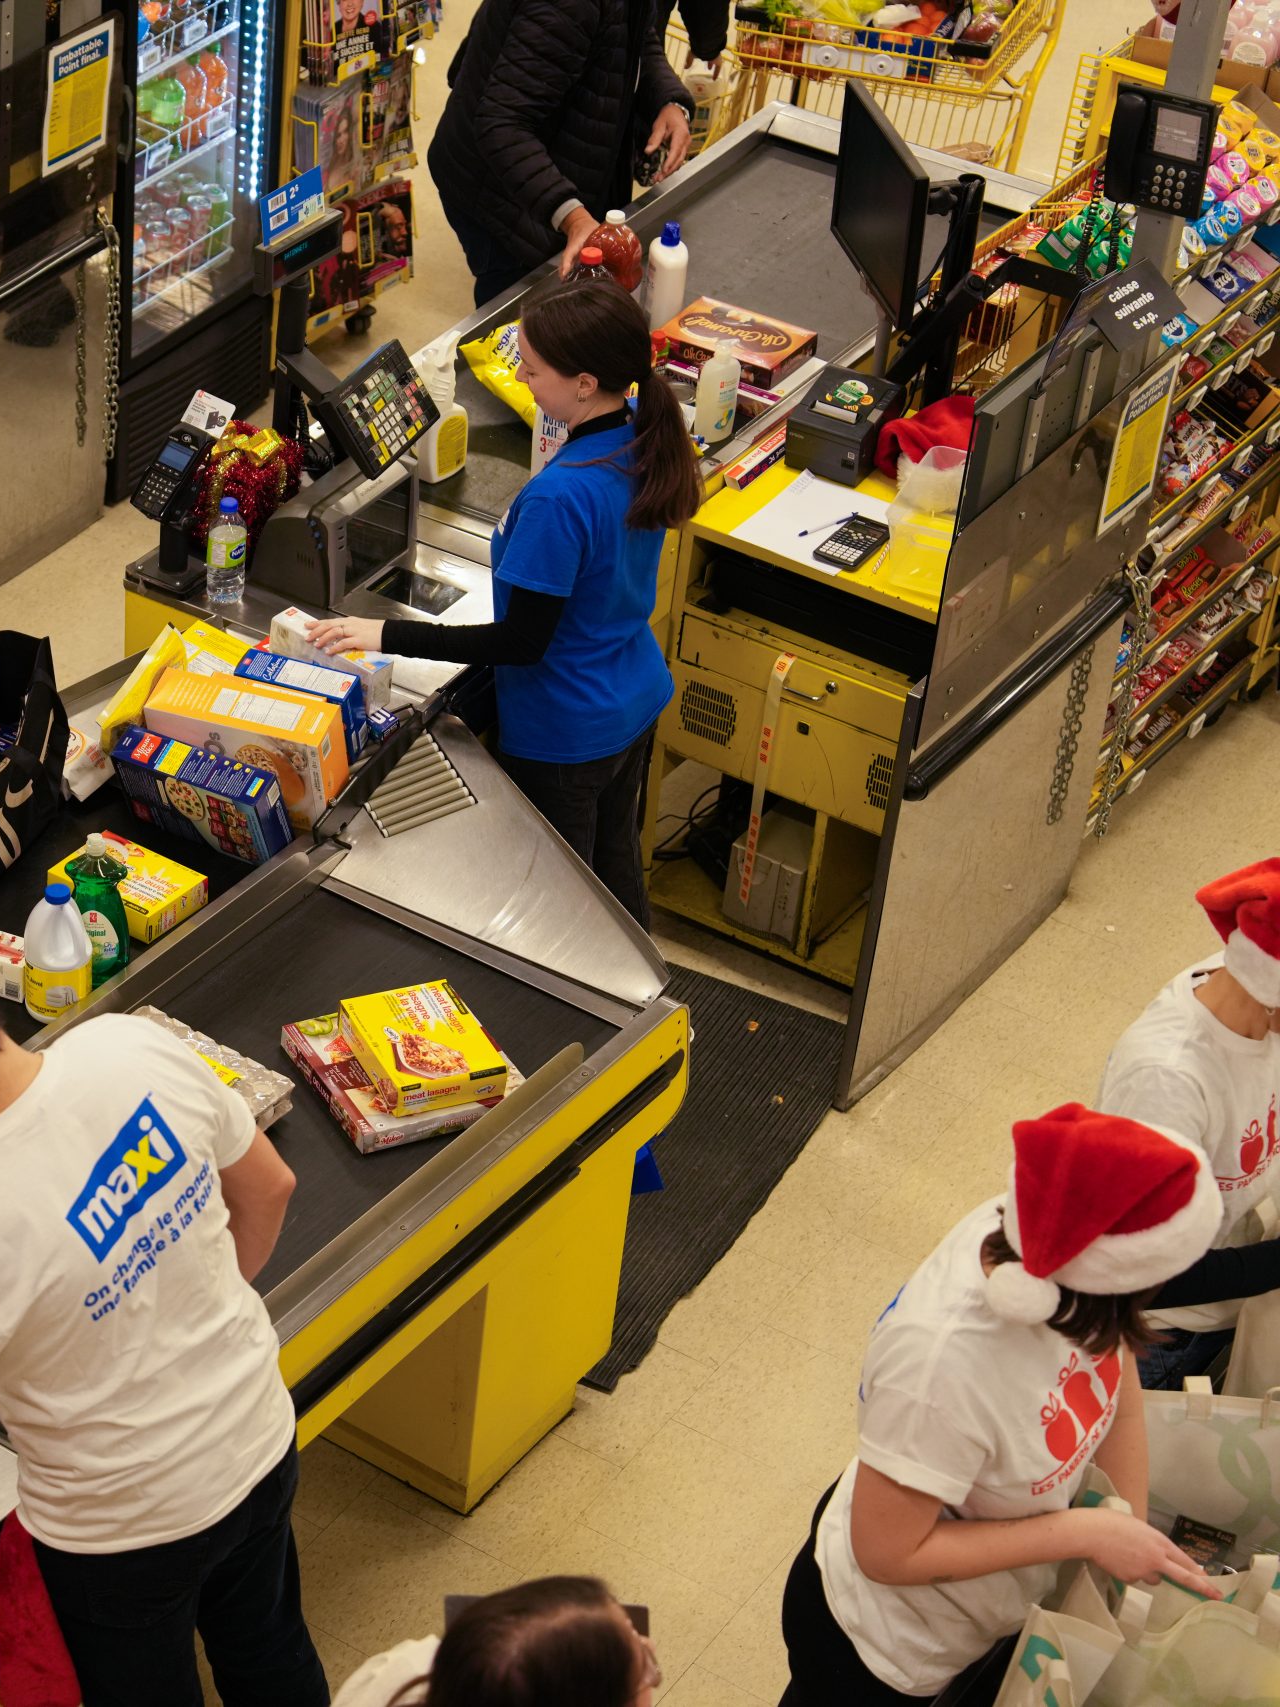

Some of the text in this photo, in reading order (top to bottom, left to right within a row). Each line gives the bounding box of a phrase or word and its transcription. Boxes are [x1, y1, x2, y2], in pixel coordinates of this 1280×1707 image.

[58, 38, 104, 65] Imbattable.
[58, 50, 100, 76] Point final.
[1108, 280, 1140, 303] caisse
[1115, 292, 1154, 320] suivante
[1133, 312, 1158, 329] s.v.p.
[492, 325, 518, 356] regula
[507, 350, 521, 370] nat
[1128, 402, 1147, 421] Point
[543, 424, 558, 438] LAIT
[540, 437, 546, 452] 3
[1191, 441, 1208, 462] bueno
[1144, 711, 1171, 741] CARAMILK
[133, 736, 151, 759] Minute
[144, 742, 155, 757] Rice
[138, 892, 158, 907] butter
[400, 998, 409, 1006] la
[406, 1007, 425, 1032] viande
[408, 990, 430, 1020] lasagne
[429, 986, 466, 1035] meat lasagna
[404, 1092, 425, 1101] meat
[428, 1085, 460, 1096] lasagna
[77, 1115, 175, 1244] maxi
[1218, 1182, 1233, 1191] ES
[84, 1285, 110, 1308] On
[112, 1227, 155, 1285] change
[157, 1213, 173, 1230] le
[91, 1293, 121, 1322] une
[170, 1227, 181, 1242] à
[180, 1213, 192, 1230] la
[1032, 1480, 1054, 1496] LES
